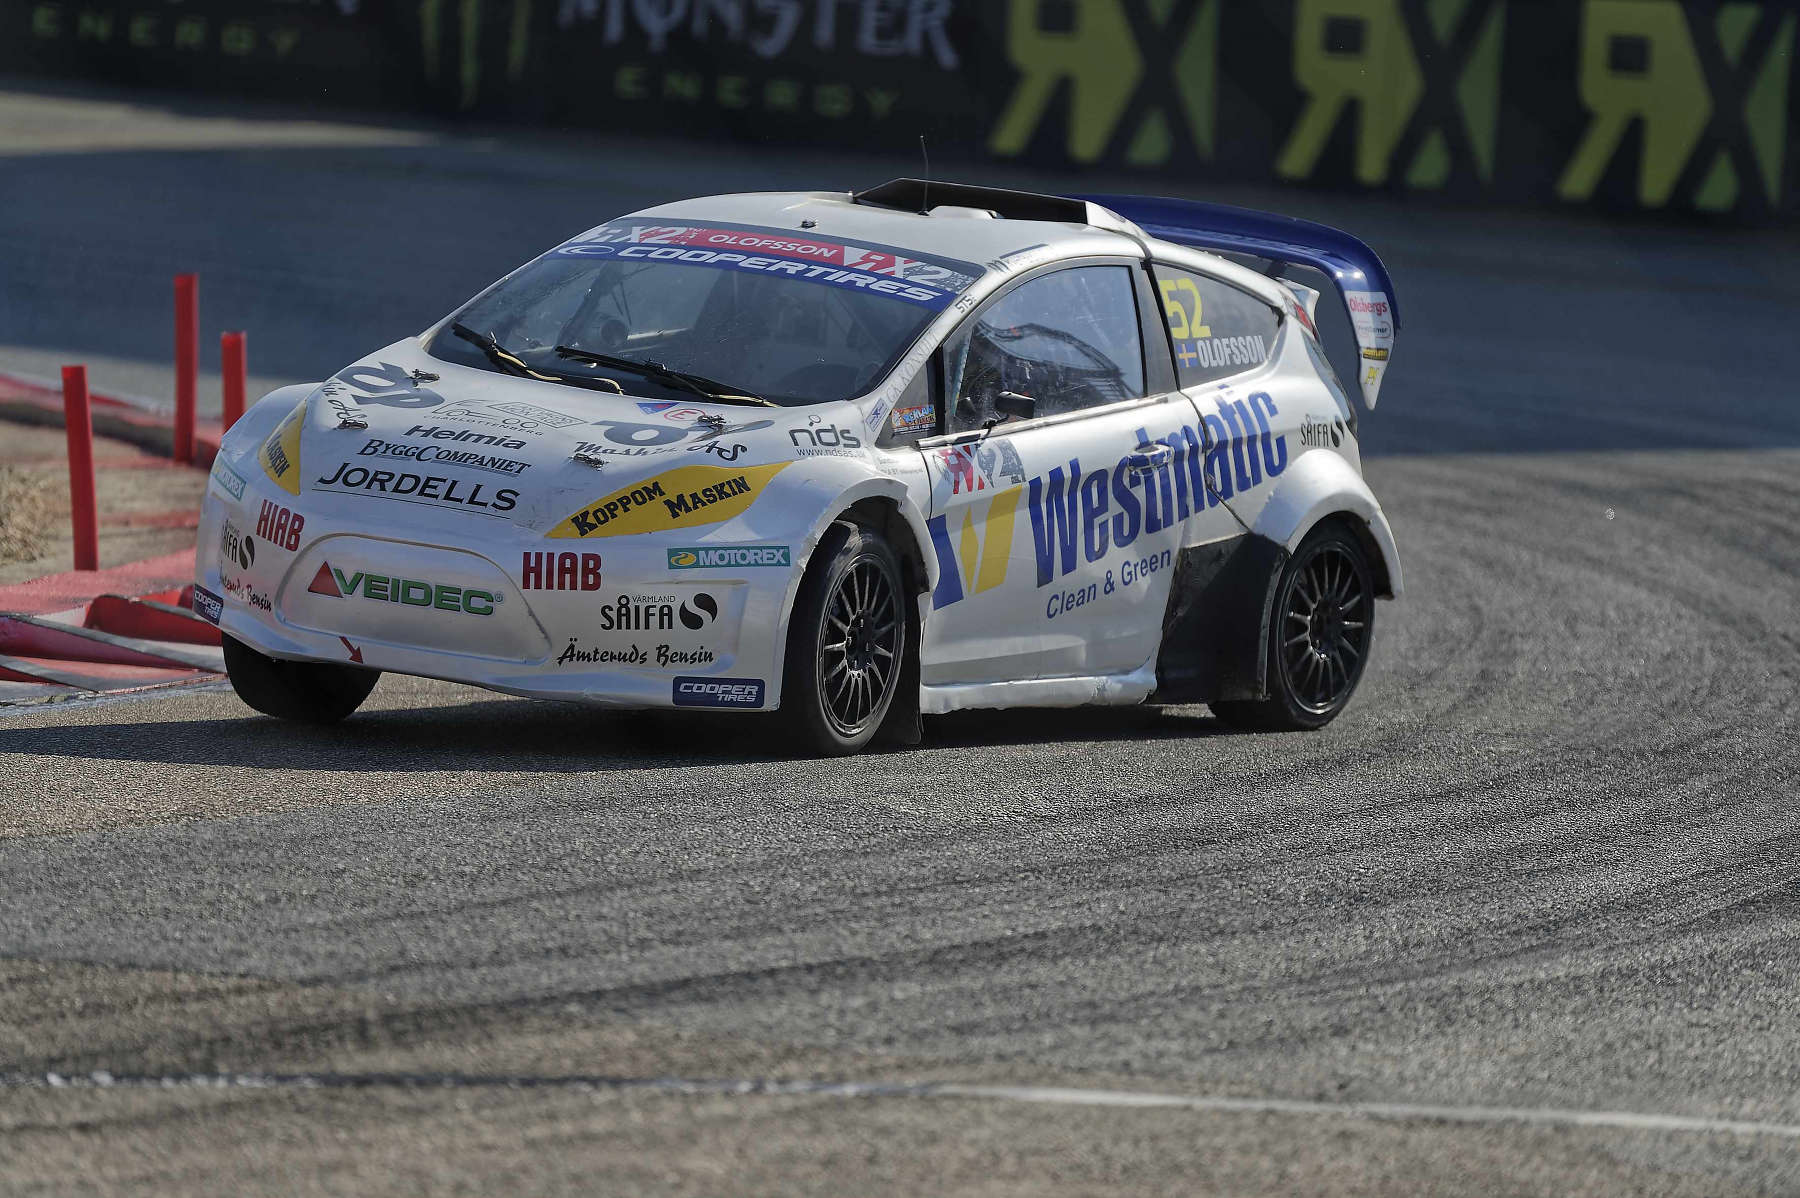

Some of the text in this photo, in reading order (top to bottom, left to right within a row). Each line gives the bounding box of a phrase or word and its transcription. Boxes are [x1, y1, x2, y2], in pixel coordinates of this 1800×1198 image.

[708, 234, 788, 258] OLOFSSON
[1160, 278, 1211, 339] 52
[1196, 335, 1267, 368] OLOFSSON
[403, 424, 527, 450] Helmia
[788, 424, 861, 449] nds
[317, 462, 521, 512] JORDELLS
[1029, 383, 1288, 588] Westmatic
[256, 499, 305, 552] HIAB
[522, 551, 602, 592] HIAB
[698, 549, 787, 567] MOTOREX
[333, 567, 495, 616] VEIDEC
[1046, 549, 1172, 619] Clean & Green
[600, 594, 673, 631] SÅIFA
[557, 638, 714, 668] Ämteruds Bensin
[679, 682, 759, 696] COOPER
[717, 693, 756, 703] TIRES
